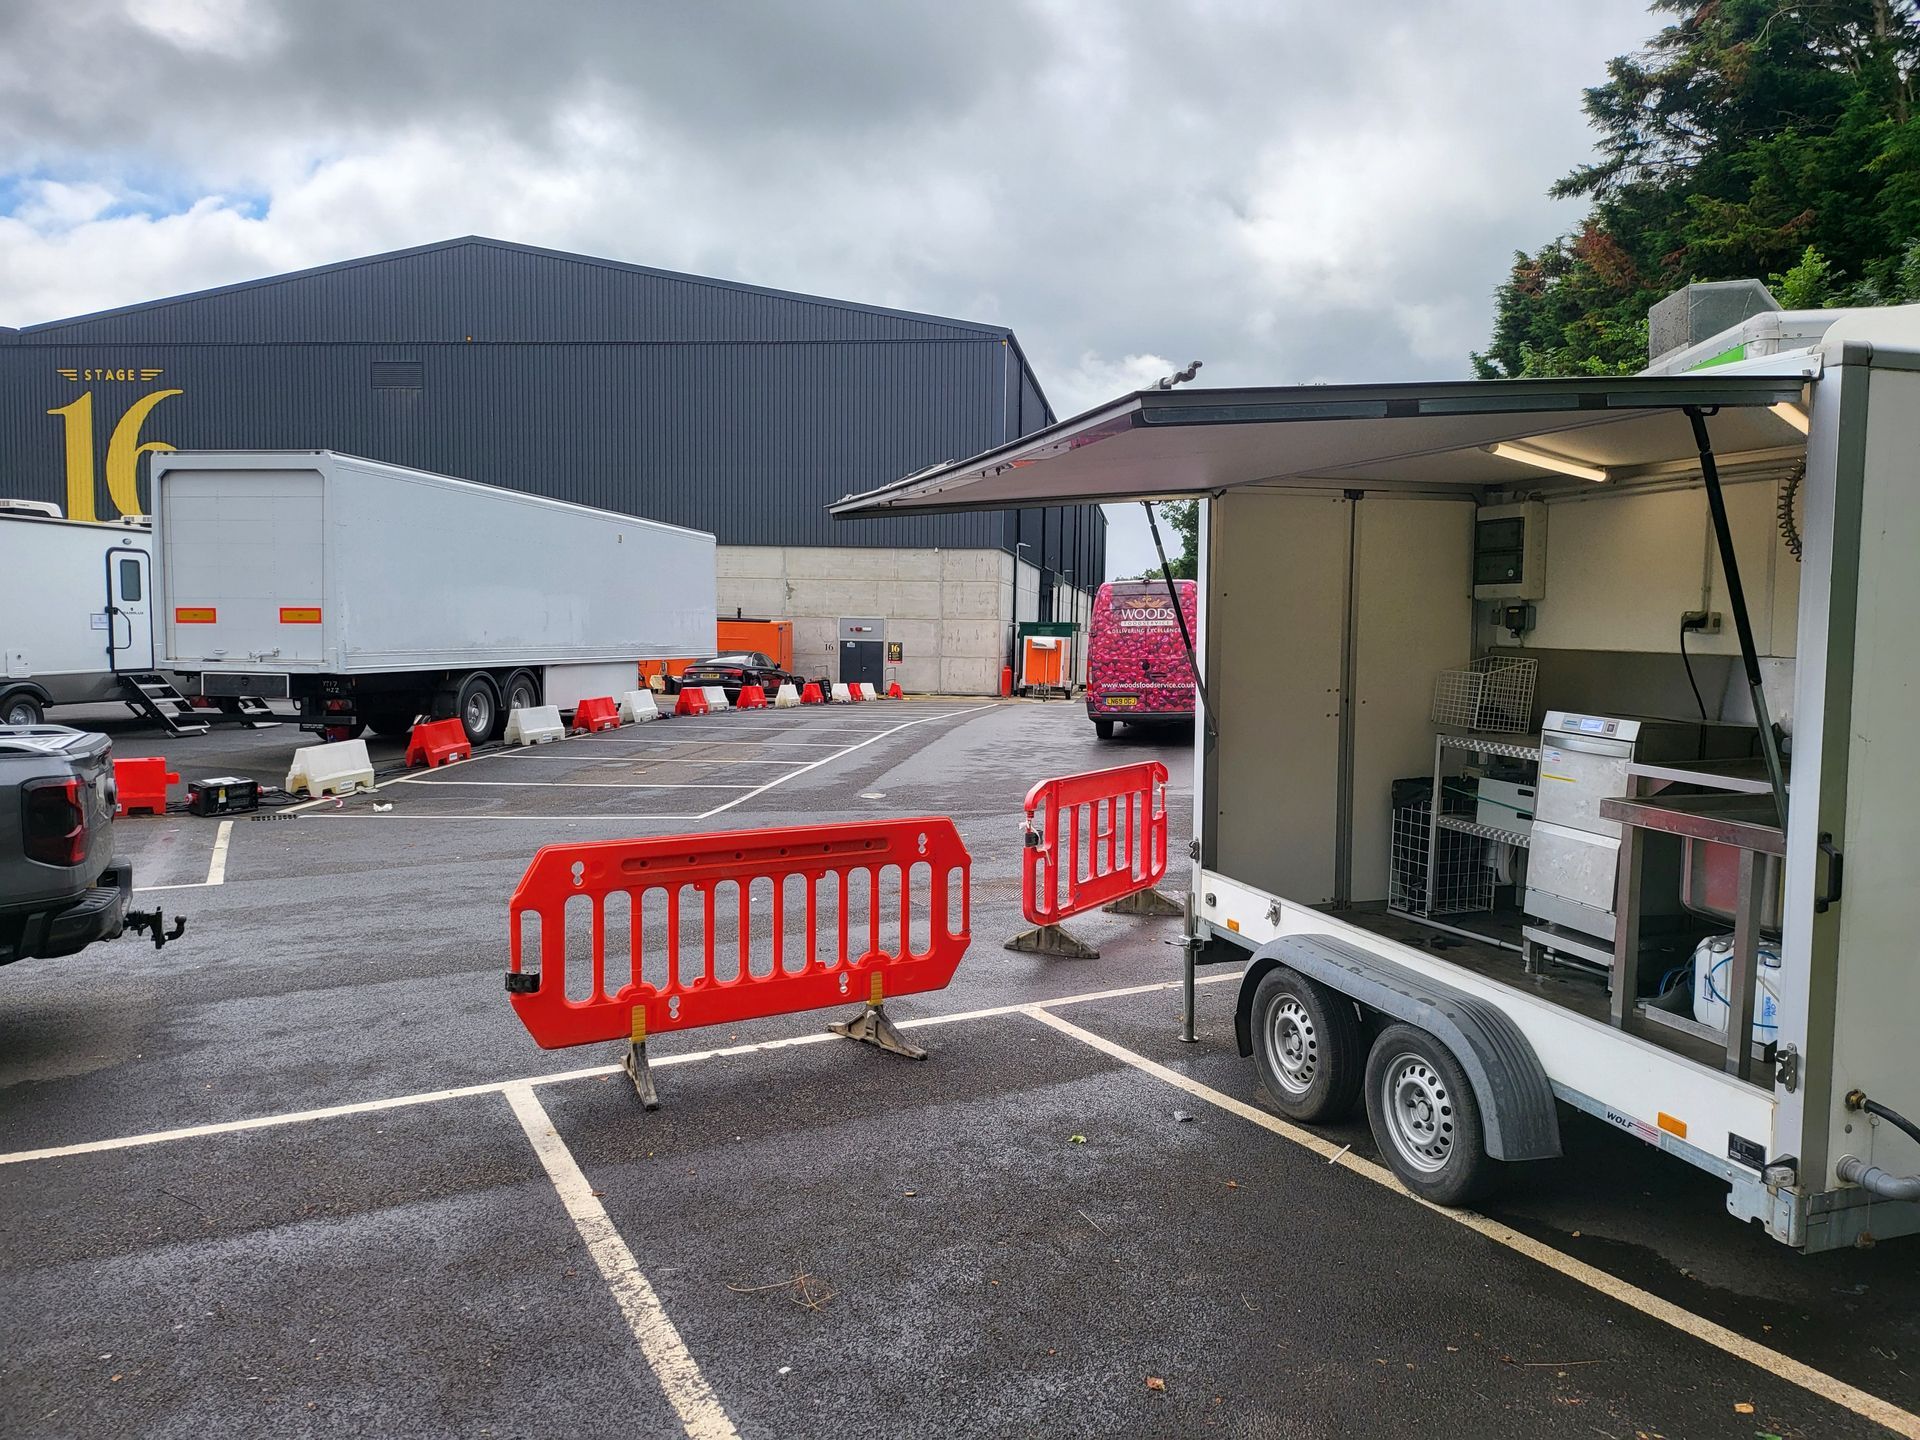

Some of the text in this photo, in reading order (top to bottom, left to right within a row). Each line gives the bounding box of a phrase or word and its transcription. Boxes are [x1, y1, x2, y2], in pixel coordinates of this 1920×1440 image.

[84, 369, 135, 381] STAGE
[47, 389, 184, 523] 16
[1121, 608, 1175, 620] WOODS
[824, 643, 834, 651] 16
[891, 644, 900, 653] 16
[1101, 681, 1195, 689] www.woodsfoodservice.co.uk
[1606, 1111, 1634, 1129] WOLF
